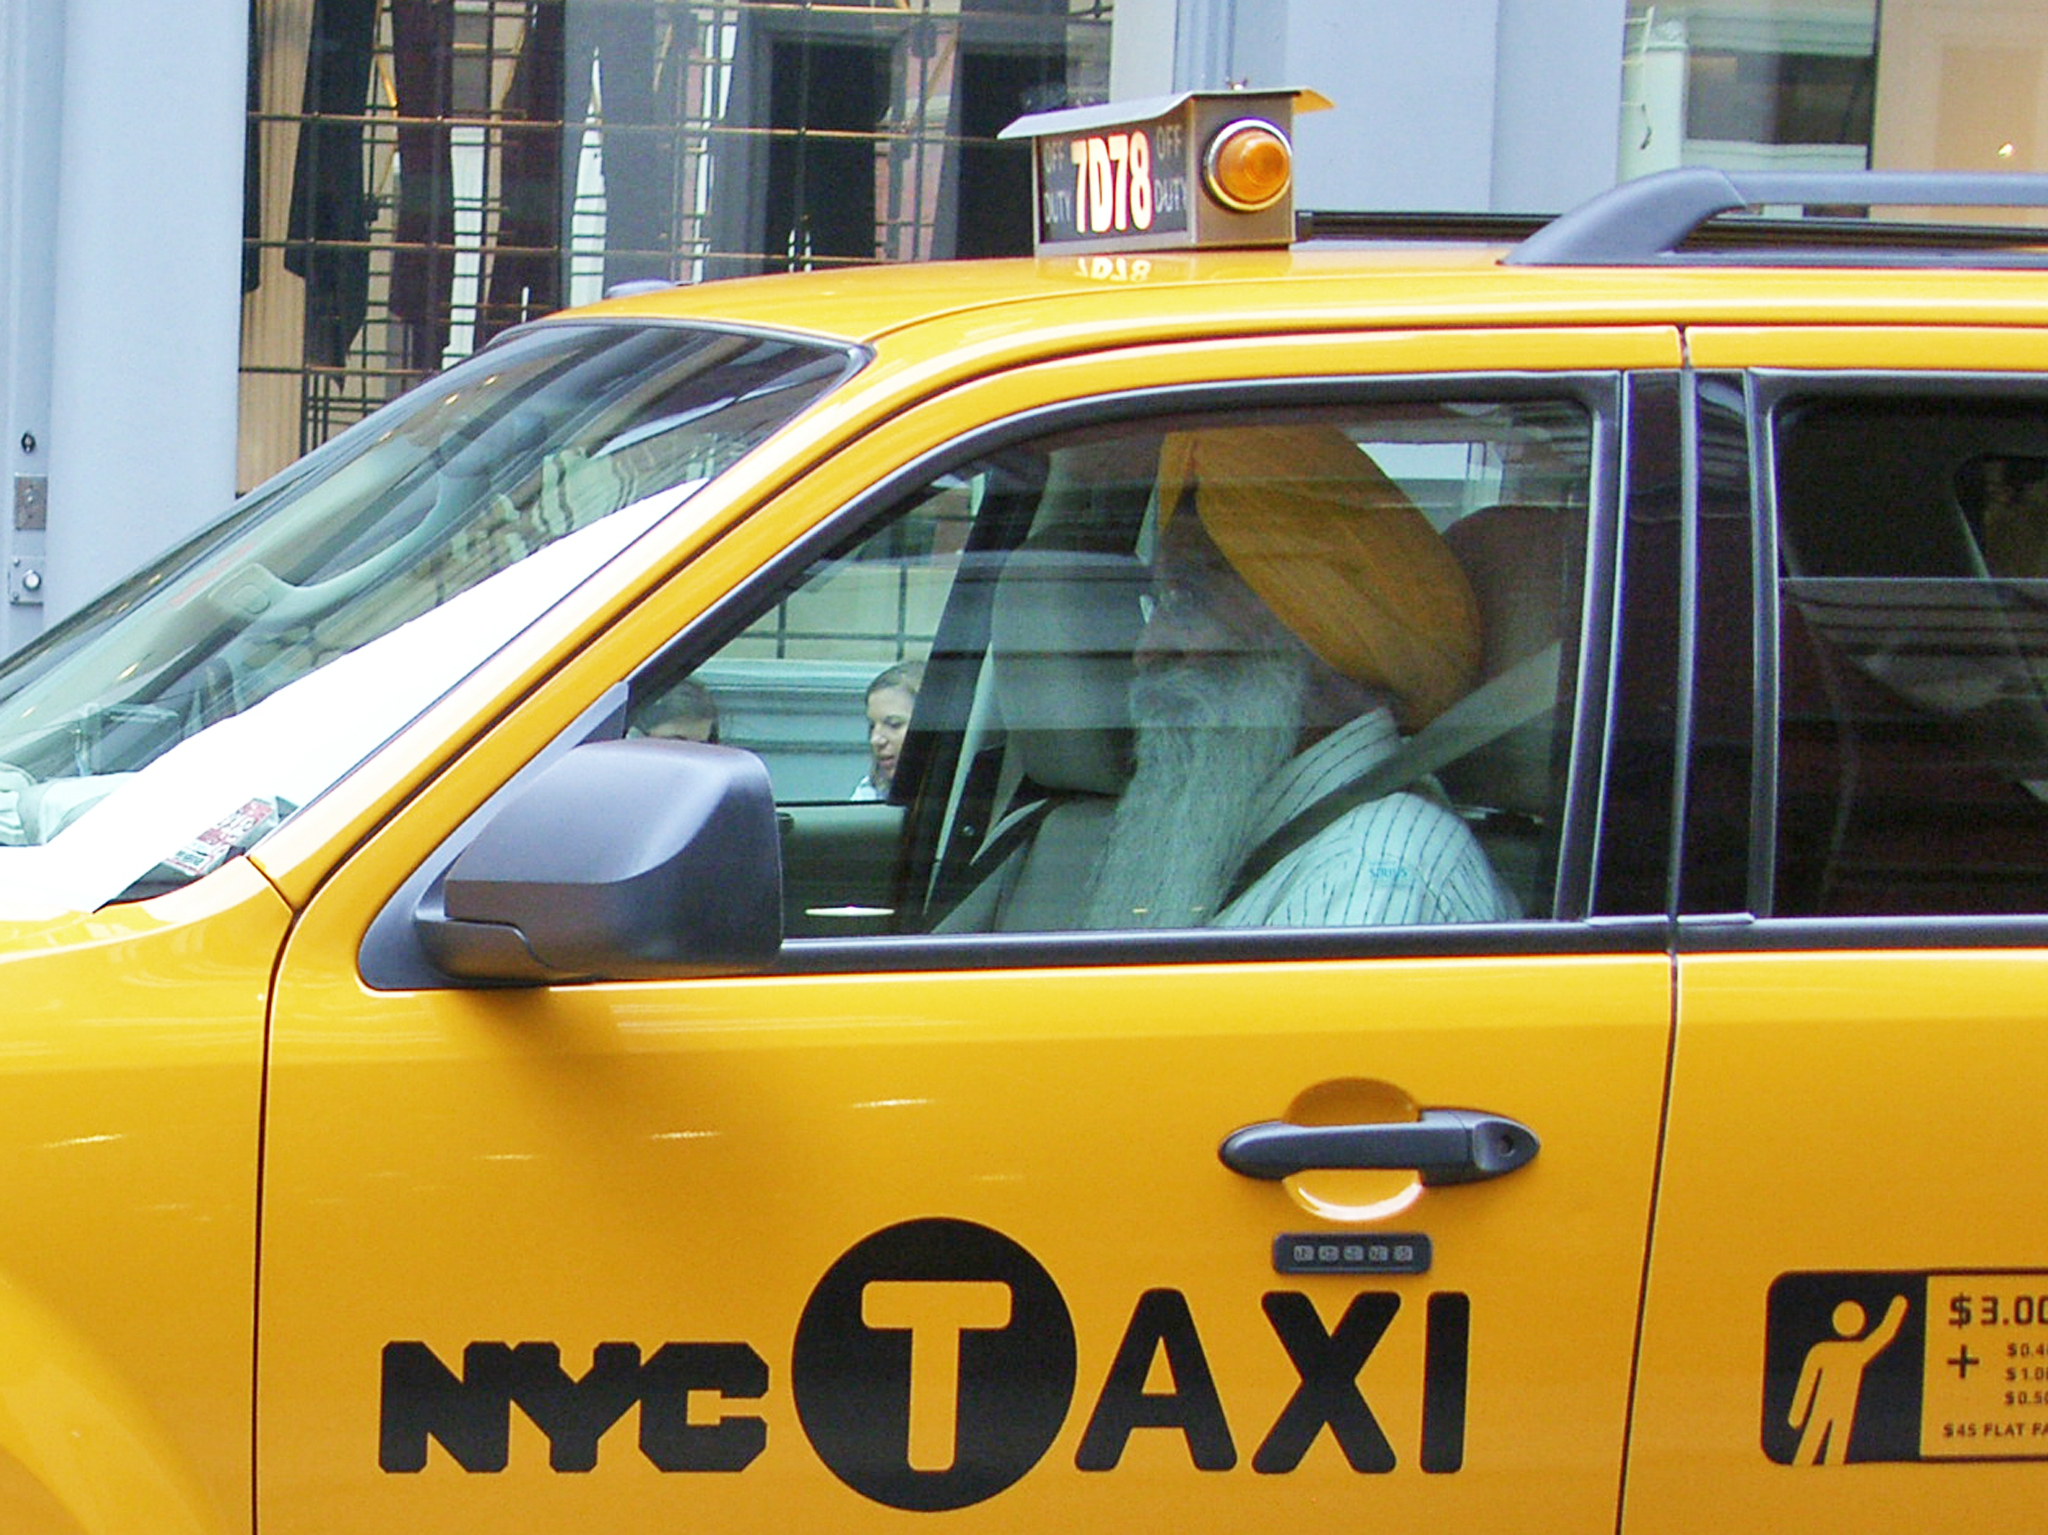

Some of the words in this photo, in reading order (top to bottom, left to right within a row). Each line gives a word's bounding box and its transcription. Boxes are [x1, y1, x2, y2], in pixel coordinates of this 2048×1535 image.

[1157, 124, 1182, 160] OFF
[1071, 130, 1152, 234] 7D78
[1154, 178, 1187, 213] DUTY
[379, 1340, 770, 1474] NYC
[861, 1280, 1471, 1474] TAXI
[1943, 1423, 1977, 1438] $45
[1984, 1423, 2024, 1437] FLAT
